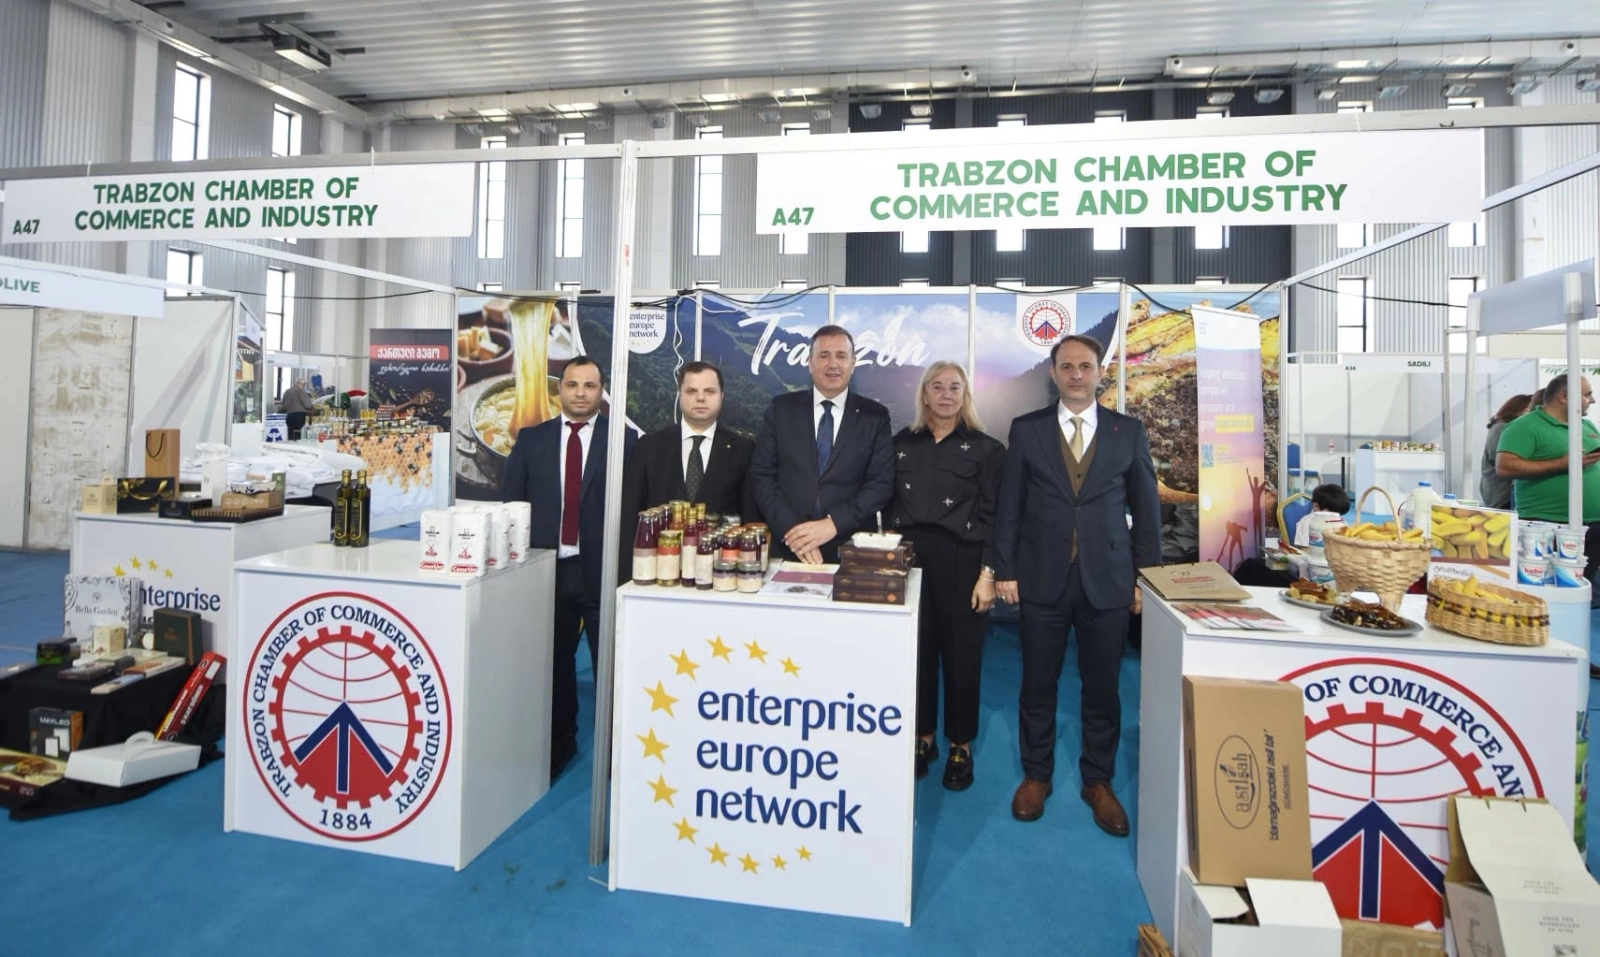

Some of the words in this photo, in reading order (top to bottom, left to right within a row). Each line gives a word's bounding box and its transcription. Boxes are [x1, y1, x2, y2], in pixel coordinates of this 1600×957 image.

[897, 158, 1057, 188] TRABZON
[1074, 152, 1246, 183] CHAMBER
[1265, 150, 1316, 178] OF
[94, 182, 195, 204] TRABZON
[205, 178, 314, 201] CHAMBER
[326, 177, 359, 199] OF
[870, 191, 1059, 220] COMMERCE
[1076, 189, 1148, 216] AND
[1166, 183, 1348, 214] INDUSTRY
[13, 219, 40, 235] A47
[75, 208, 195, 230] COMMERCE
[205, 206, 251, 228] AND
[262, 204, 378, 227] INDUSTRY
[772, 207, 815, 226] A47
[629, 313, 665, 322] enterprise
[629, 322, 655, 331] europe
[629, 329, 659, 338] network
[738, 311, 930, 376] Trazon
[75, 605, 92, 614] Bella
[139, 585, 221, 612] nterprise
[304, 607, 326, 626] OF
[331, 605, 424, 670] COMMERCE
[253, 619, 304, 703] CHAMBER
[417, 671, 439, 714] AND
[697, 687, 902, 741] enterprise
[252, 708, 292, 798] TRABZON
[1304, 677, 1341, 702] OF
[1349, 675, 1503, 759] COMMERCE
[1492, 764, 1525, 797] AN
[396, 720, 440, 814] INDUSTRY
[696, 739, 839, 790] europe
[319, 809, 372, 831] 1884
[695, 786, 863, 834] network
